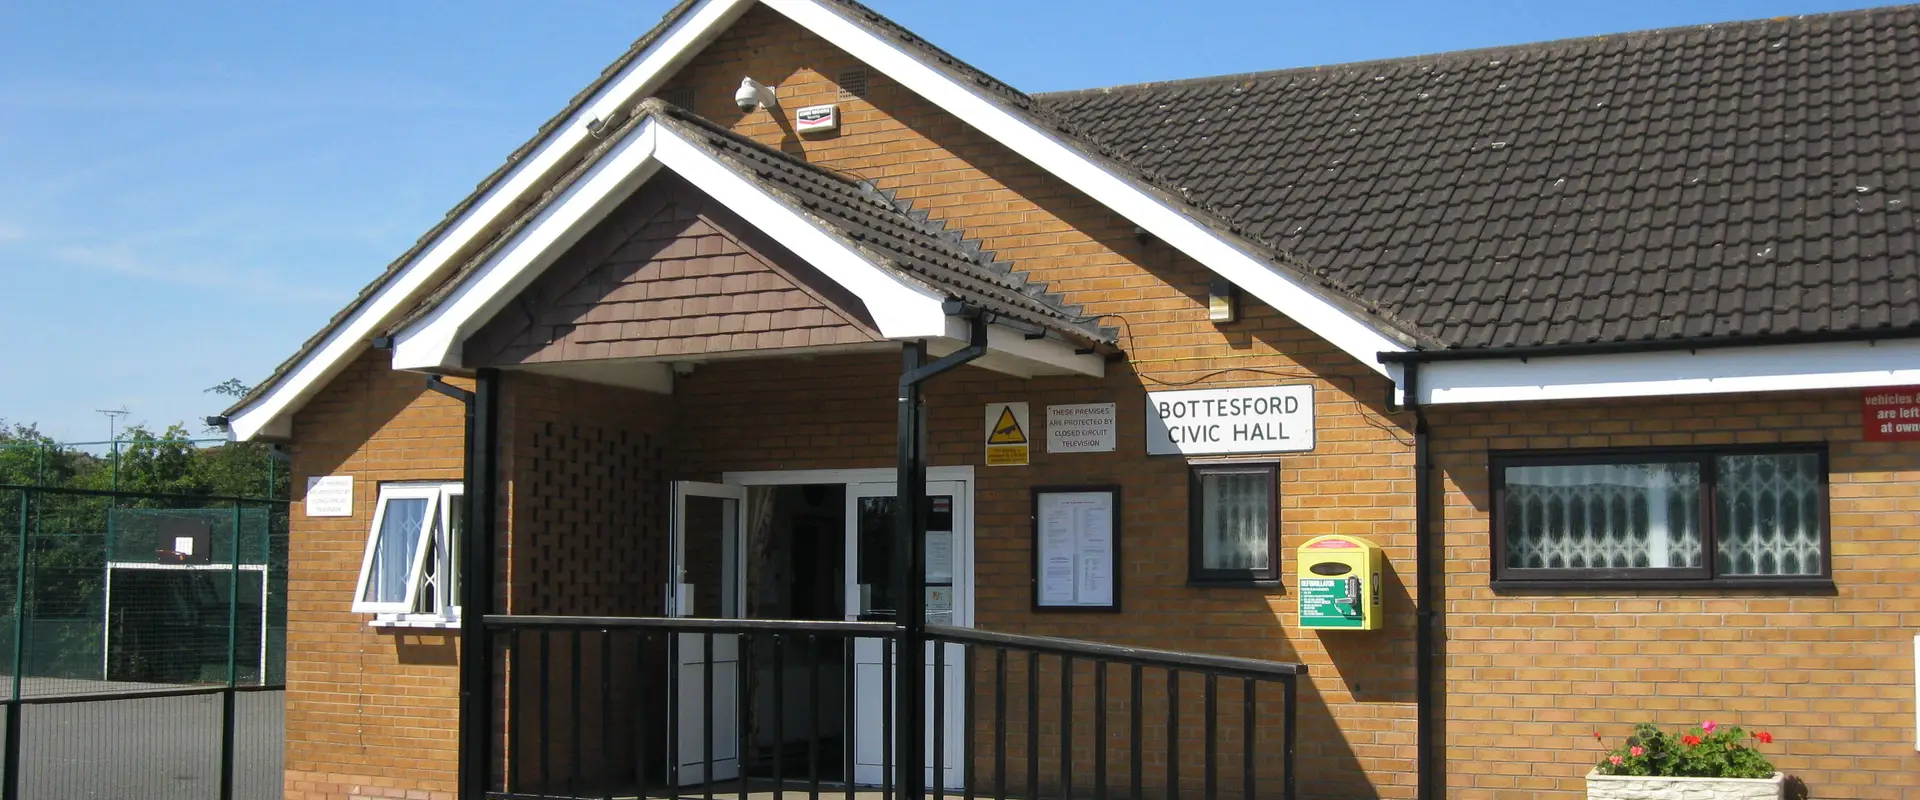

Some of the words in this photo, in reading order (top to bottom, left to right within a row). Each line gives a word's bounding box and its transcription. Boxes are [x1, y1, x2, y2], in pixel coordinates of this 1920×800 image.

[1865, 393, 1912, 405] vehicles
[1075, 407, 1110, 415] PREMISES
[1159, 396, 1298, 419] BOTTESFORD
[1877, 410, 1896, 419] are
[1900, 407, 1919, 418] left
[1168, 424, 1220, 444] CIVIC
[1233, 422, 1290, 442] HALL
[1881, 421, 1892, 433] at
